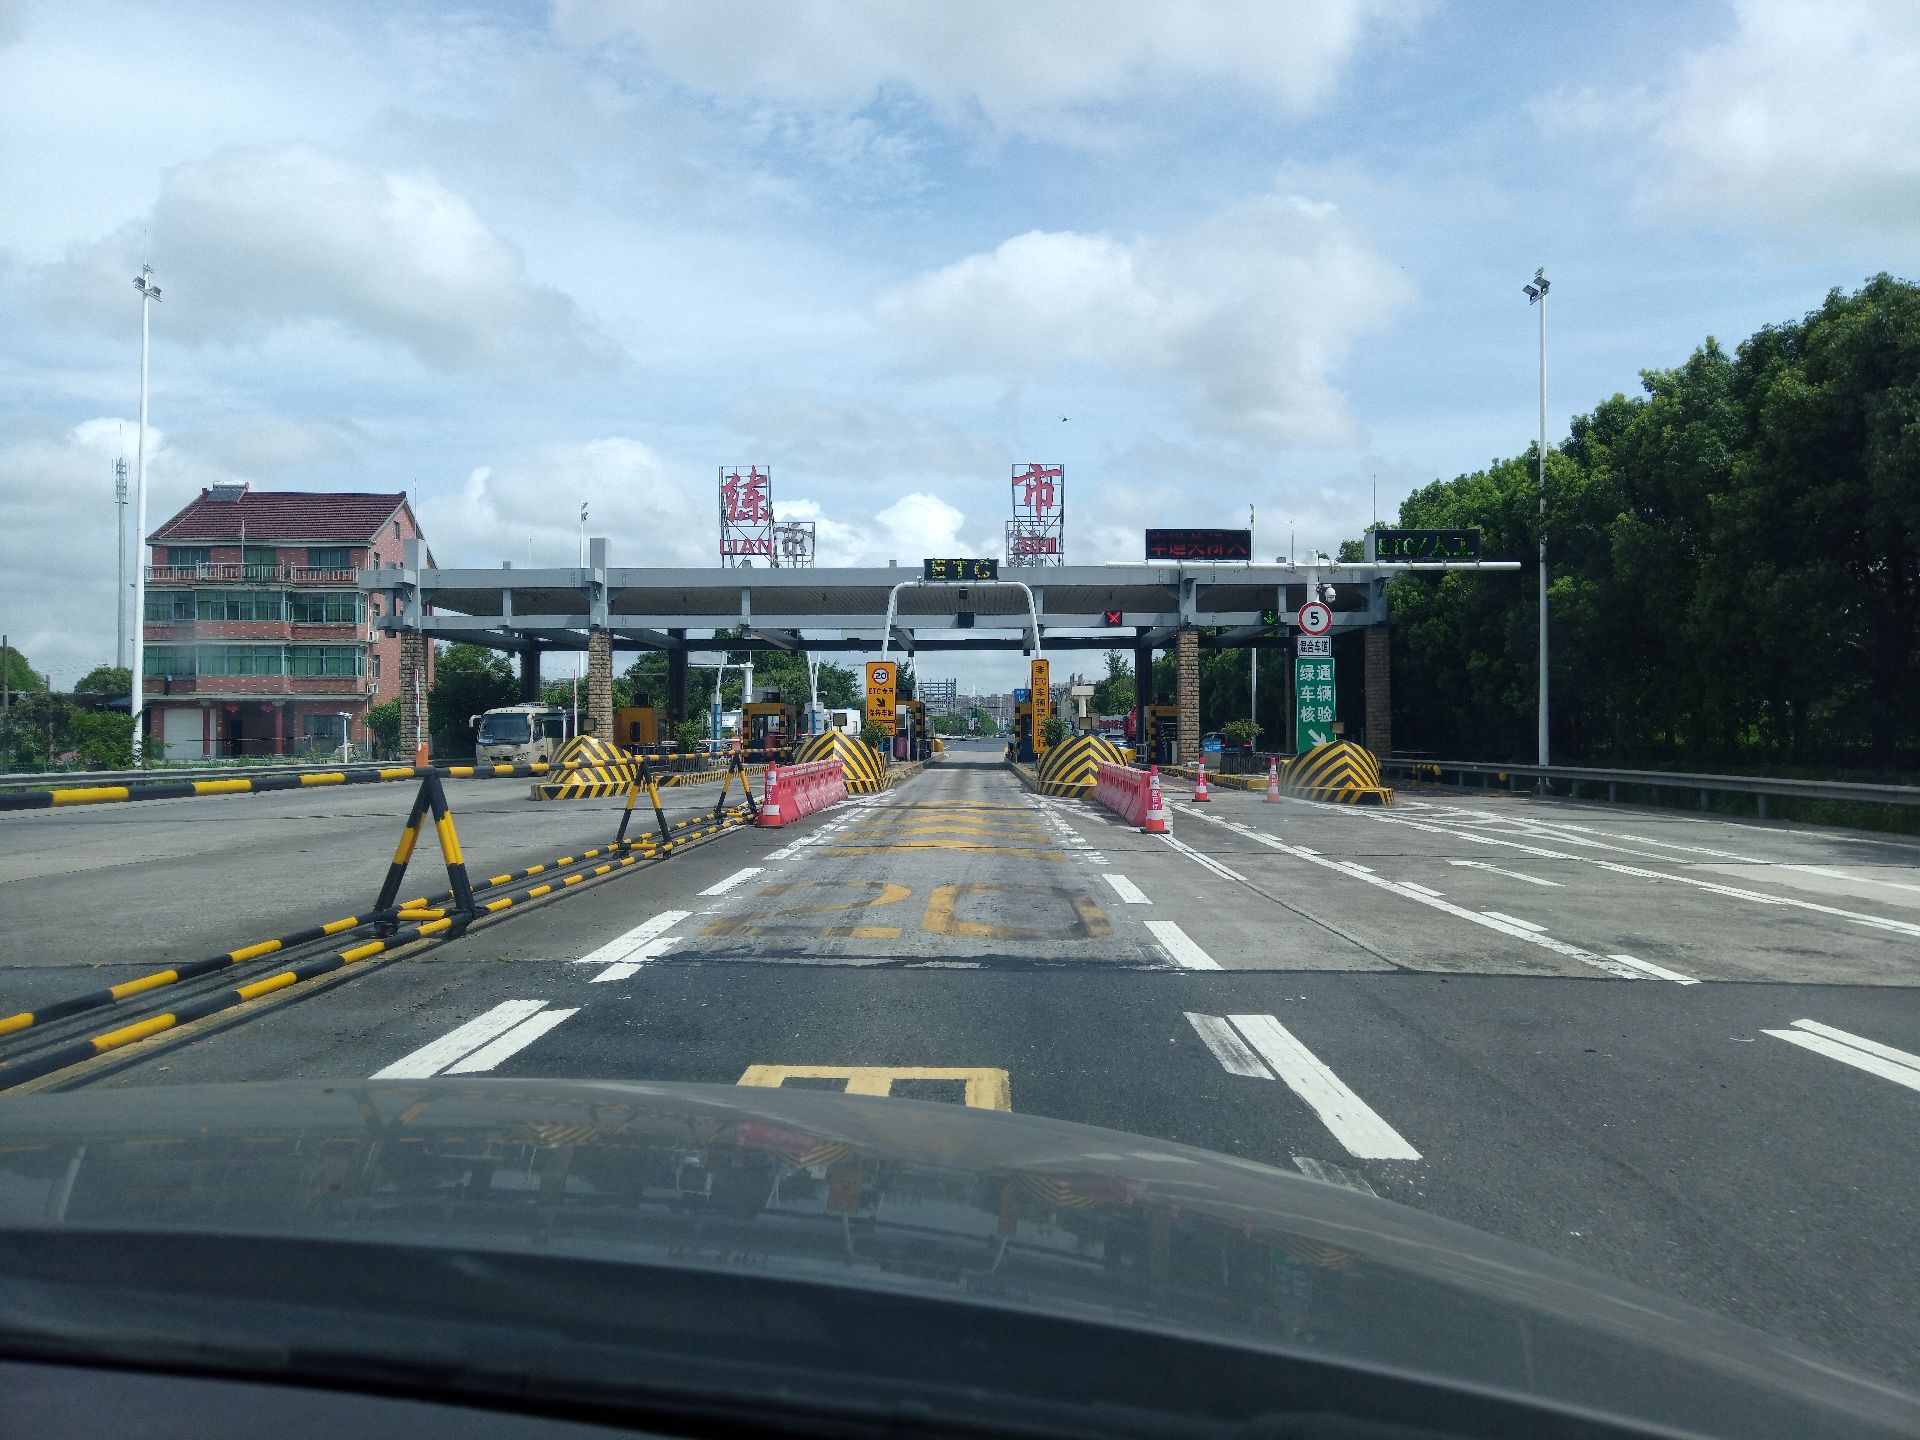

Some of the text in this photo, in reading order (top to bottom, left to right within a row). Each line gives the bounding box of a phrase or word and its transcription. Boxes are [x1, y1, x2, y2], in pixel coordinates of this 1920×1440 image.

[721, 463, 1062, 526] 练 市
[720, 537, 1056, 555] LIAN SHI
[932, 560, 990, 579] ETC
[1310, 611, 1320, 626] 5
[1299, 639, 1329, 653] 混合车道
[876, 672, 887, 680] 20
[1299, 664, 1332, 682] 绿通
[1299, 685, 1332, 702] 车辆
[1300, 705, 1333, 723] 核验
